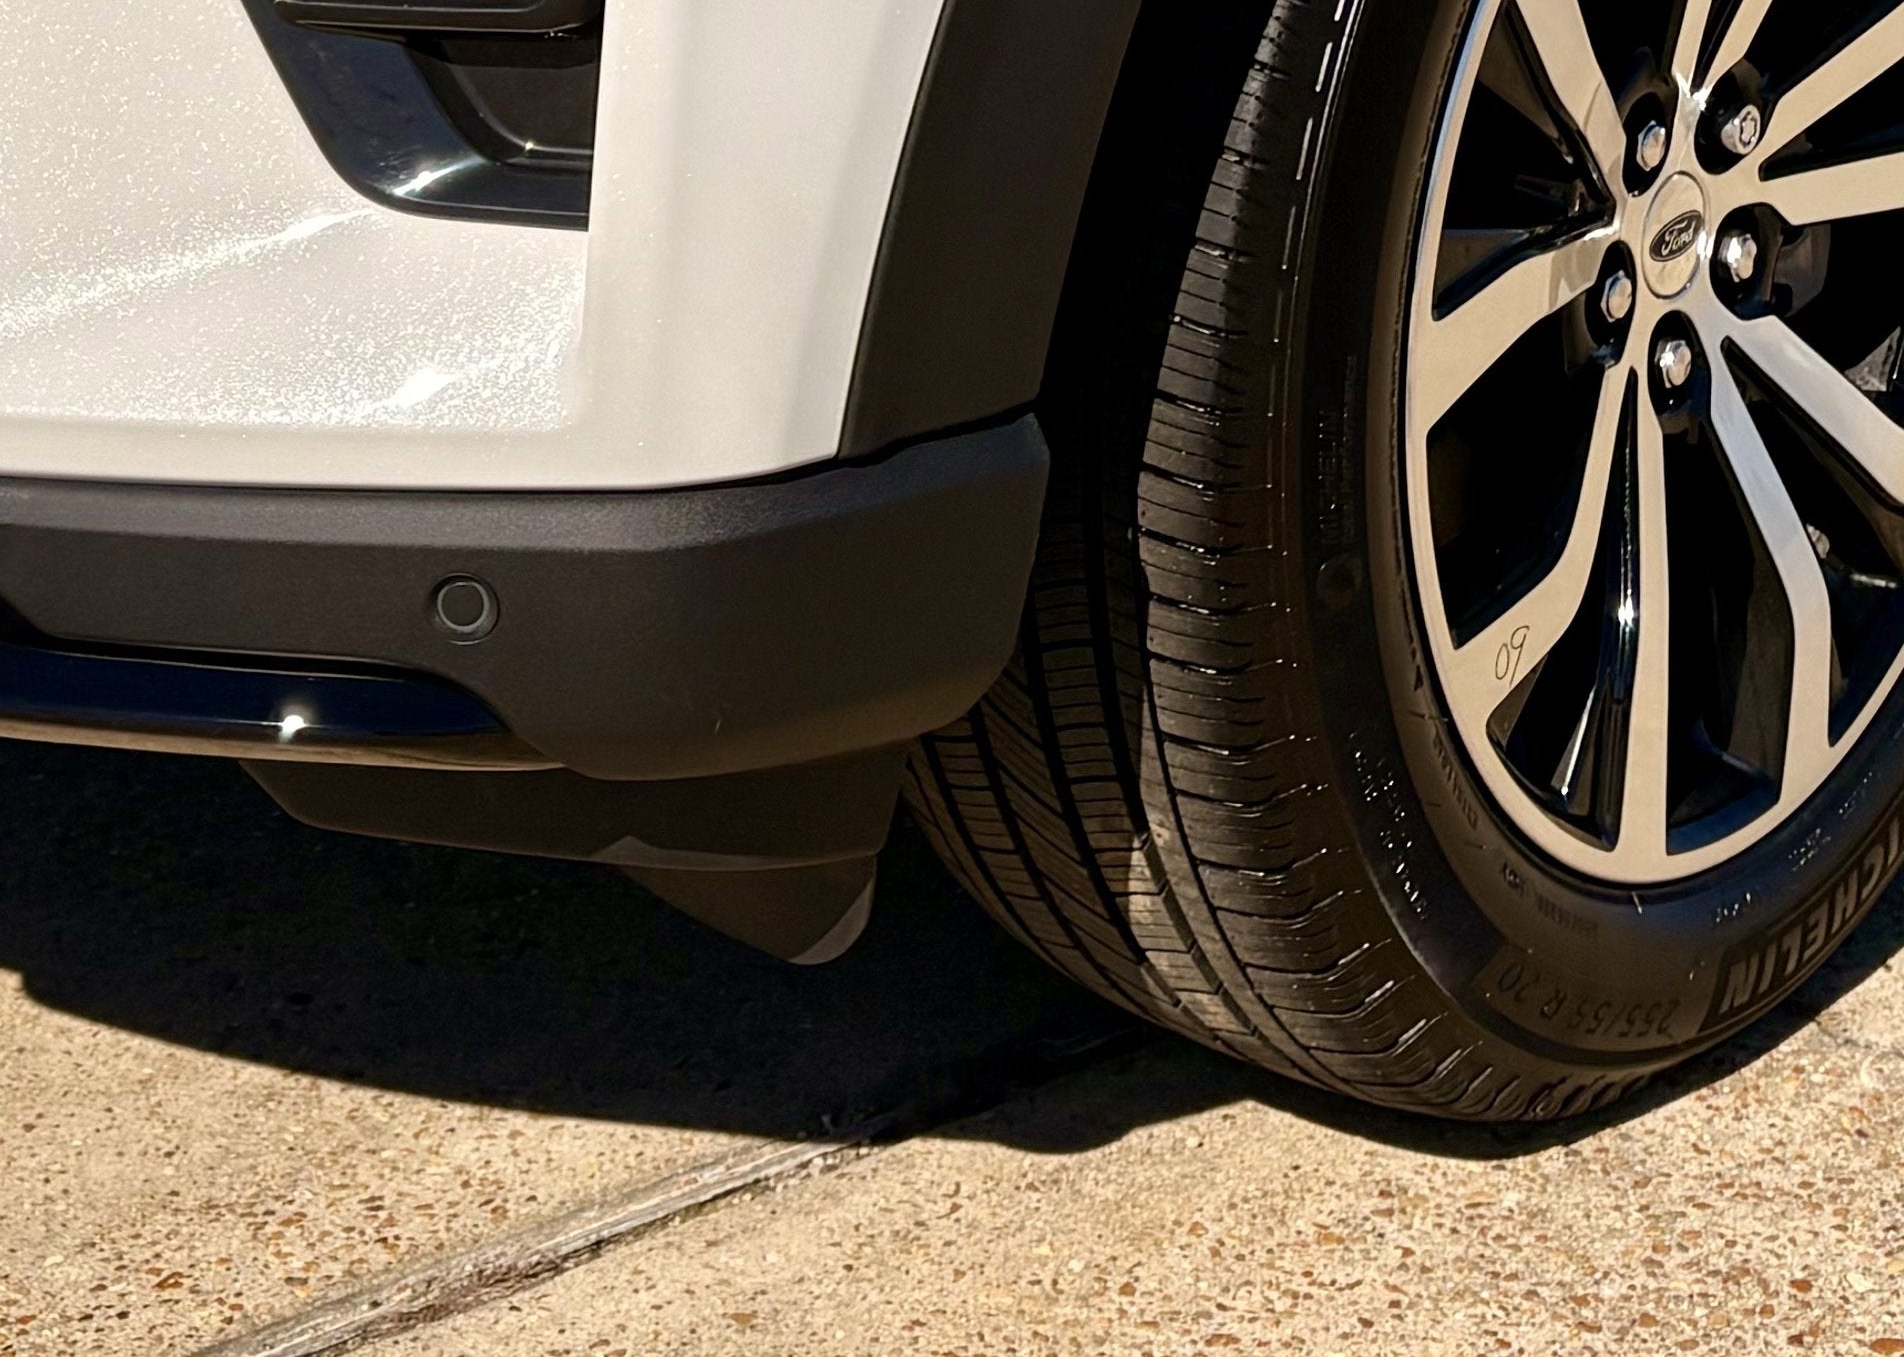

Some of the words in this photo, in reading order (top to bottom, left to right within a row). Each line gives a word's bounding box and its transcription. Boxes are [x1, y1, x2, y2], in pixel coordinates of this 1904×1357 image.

[1660, 218, 1697, 257] Ford
[1495, 624, 1531, 686] 09
[1537, 986, 1570, 1022] R
